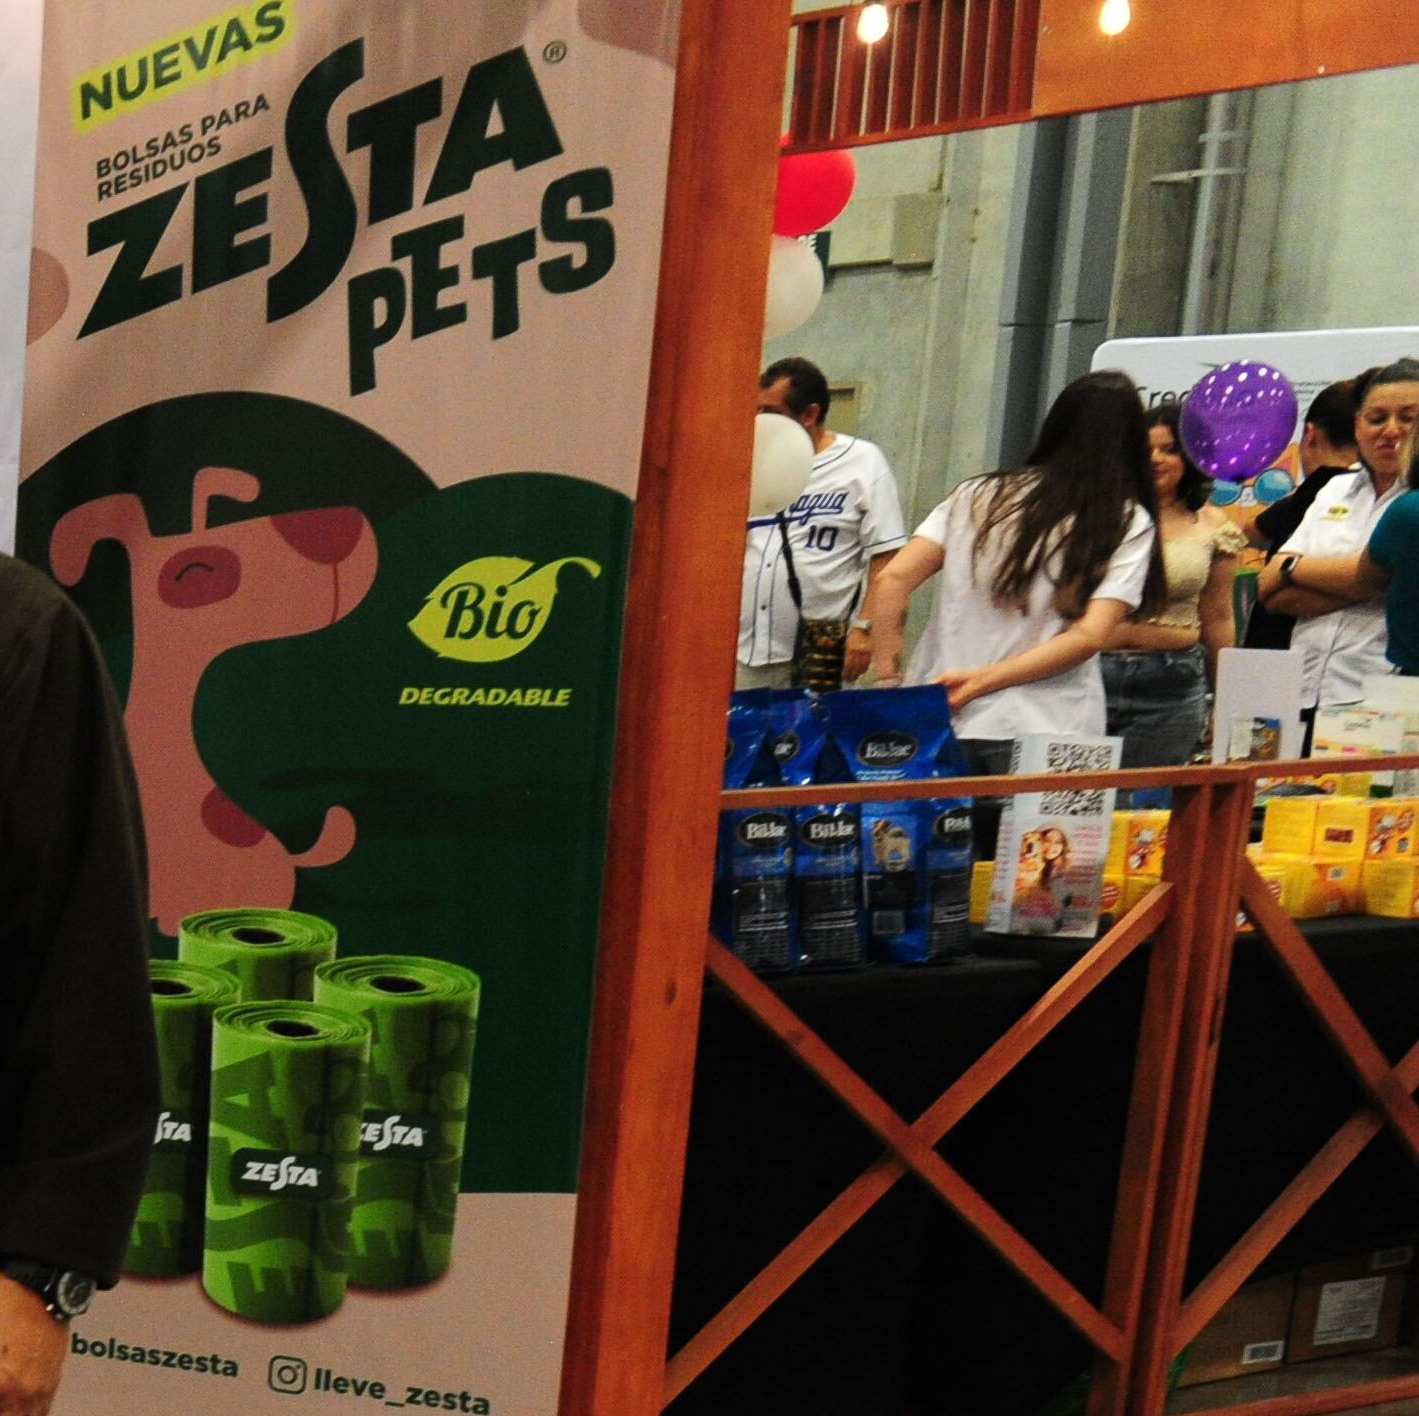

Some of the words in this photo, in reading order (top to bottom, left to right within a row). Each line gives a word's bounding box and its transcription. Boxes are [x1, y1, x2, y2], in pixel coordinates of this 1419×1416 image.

[80, 2, 286, 120] NUEVAS
[96, 126, 193, 178] BOLSAS
[201, 95, 270, 139] PARA
[75, 37, 564, 341] ZESTA
[97, 137, 221, 201] RESIDUOS
[348, 166, 616, 398] PETS
[805, 525, 838, 551] 10
[440, 581, 540, 640] Bio
[398, 687, 572, 707] DEGRADABLE
[154, 1111, 192, 1144] STA
[241, 1156, 319, 1191] ZESTA
[70, 1333, 239, 1378] bolsaszesta
[314, 1368, 490, 1416] lleve_zesta
